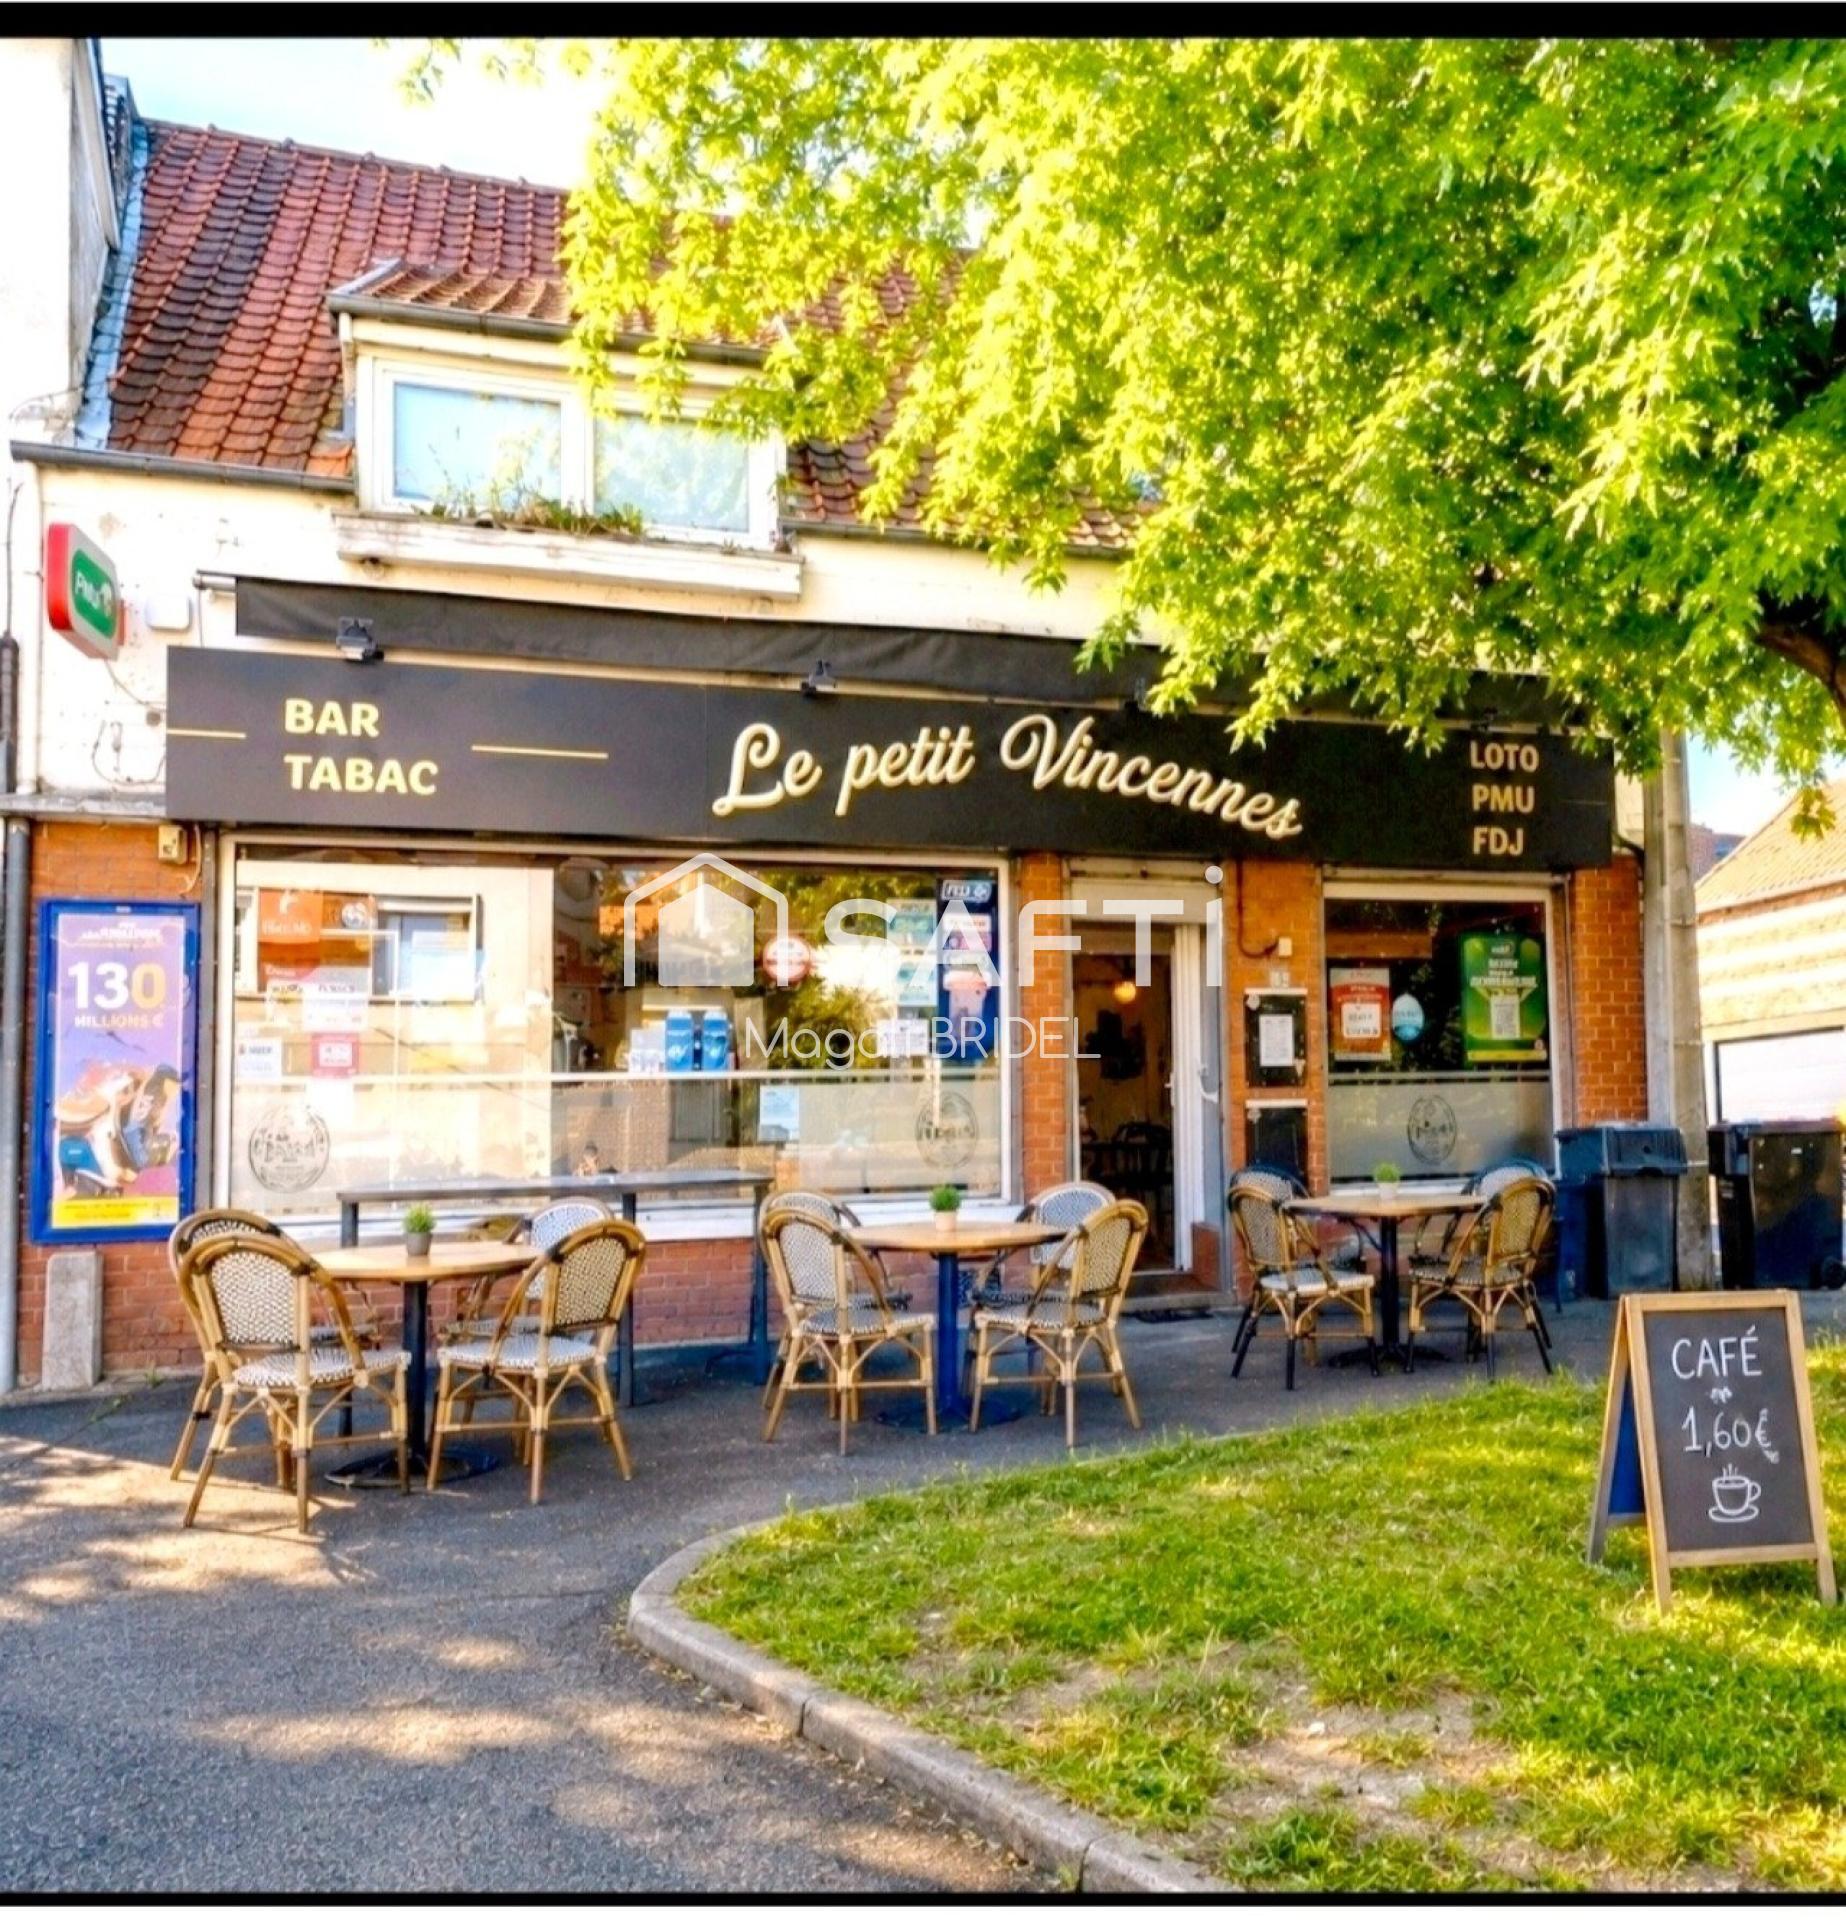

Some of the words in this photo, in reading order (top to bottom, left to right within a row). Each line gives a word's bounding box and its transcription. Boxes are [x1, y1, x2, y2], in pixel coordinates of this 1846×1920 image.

[285, 698, 380, 737] BAR
[283, 754, 439, 796] TABAC
[711, 723, 822, 816] Le
[835, 725, 975, 816] petit
[1000, 713, 1303, 840] Vincennes
[1470, 740, 1539, 773] LOTO
[1472, 783, 1536, 814] PMU
[1473, 826, 1525, 856] FDJ
[67, 961, 168, 1010] 130
[74, 1014, 148, 1029] MILLIONS
[1671, 1325, 1763, 1380] CAFÉ
[1681, 1406, 1773, 1458] 1,60€
